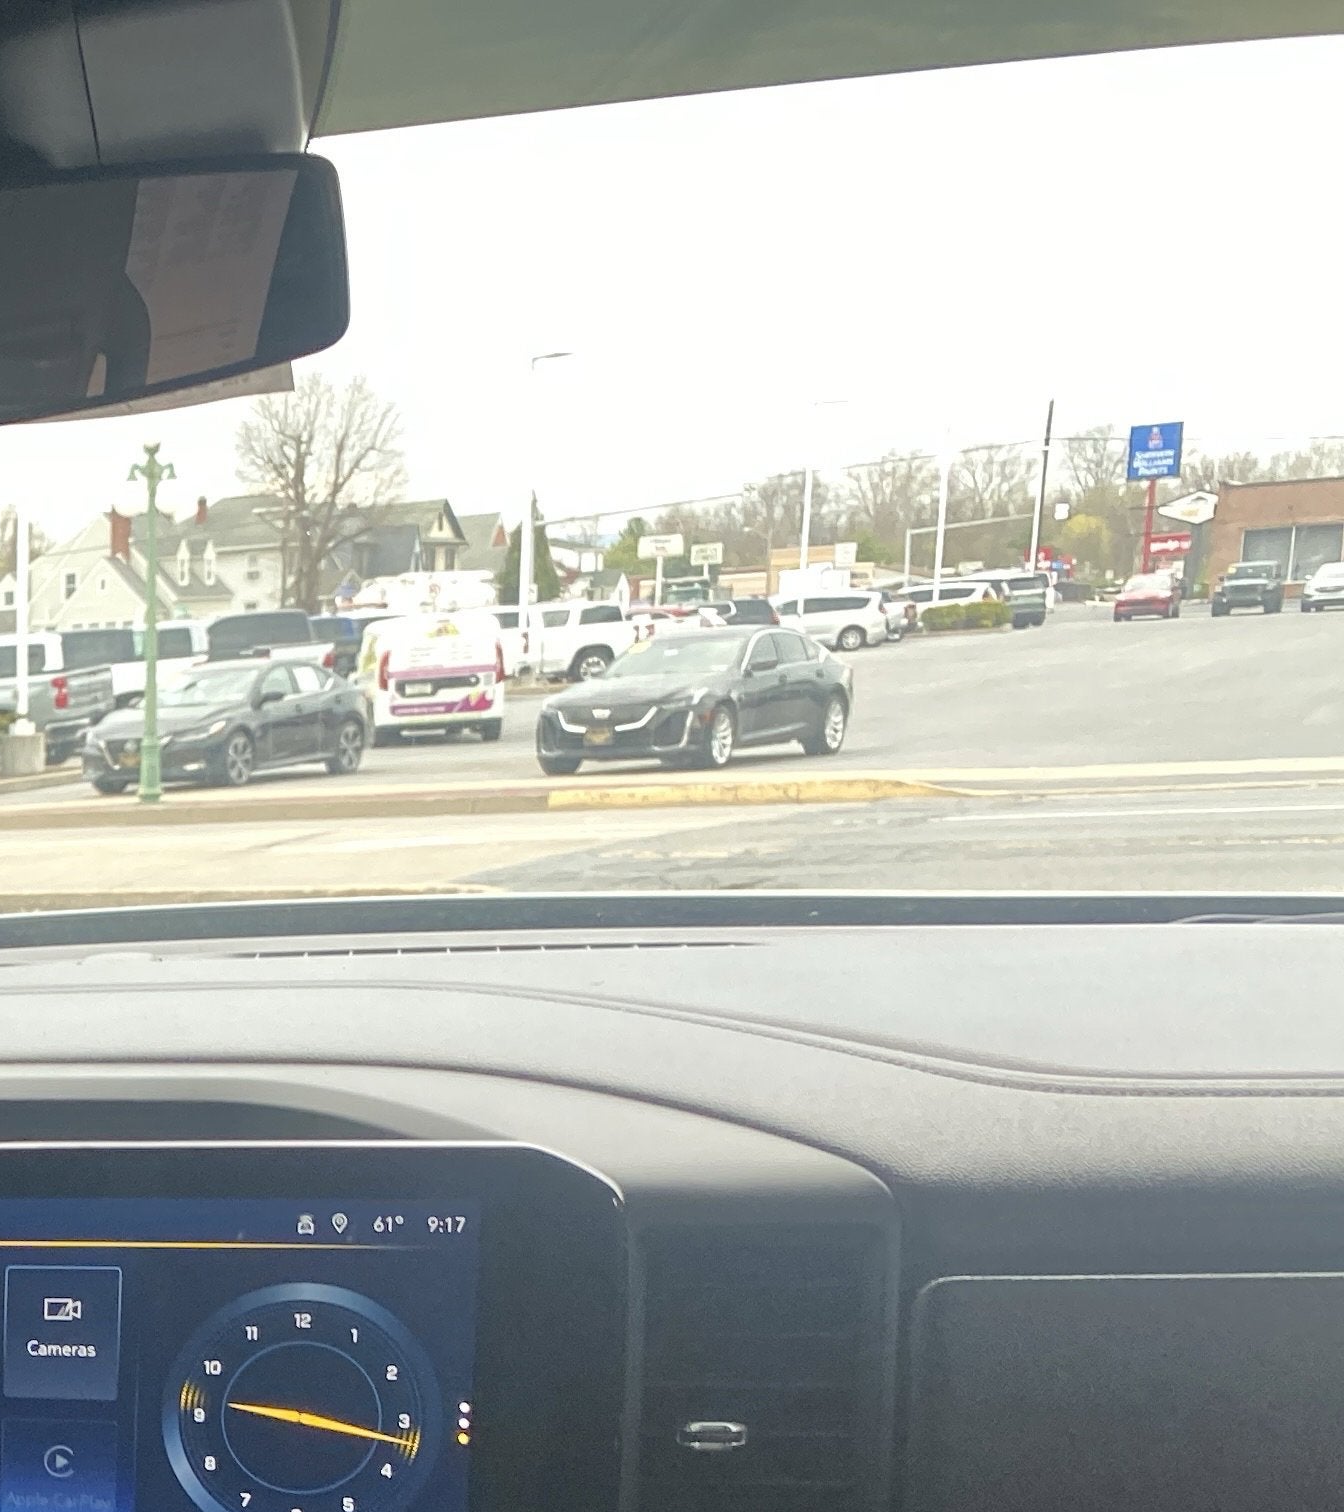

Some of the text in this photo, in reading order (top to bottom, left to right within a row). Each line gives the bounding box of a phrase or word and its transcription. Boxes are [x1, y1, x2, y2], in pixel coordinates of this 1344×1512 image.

[427, 1215, 466, 1234] 9:17
[294, 1312, 312, 1329] 12
[245, 1325, 259, 1341] 11
[350, 1327, 359, 1343] 1
[26, 1339, 97, 1358] Cameras
[203, 1359, 223, 1376] 10
[385, 1364, 398, 1382] 2
[193, 1407, 206, 1423] 9
[398, 1413, 411, 1429] 3
[204, 1455, 217, 1471] 8
[380, 1463, 393, 1479] 4
[239, 1491, 252, 1508] 7
[341, 1496, 355, 1512] 5
